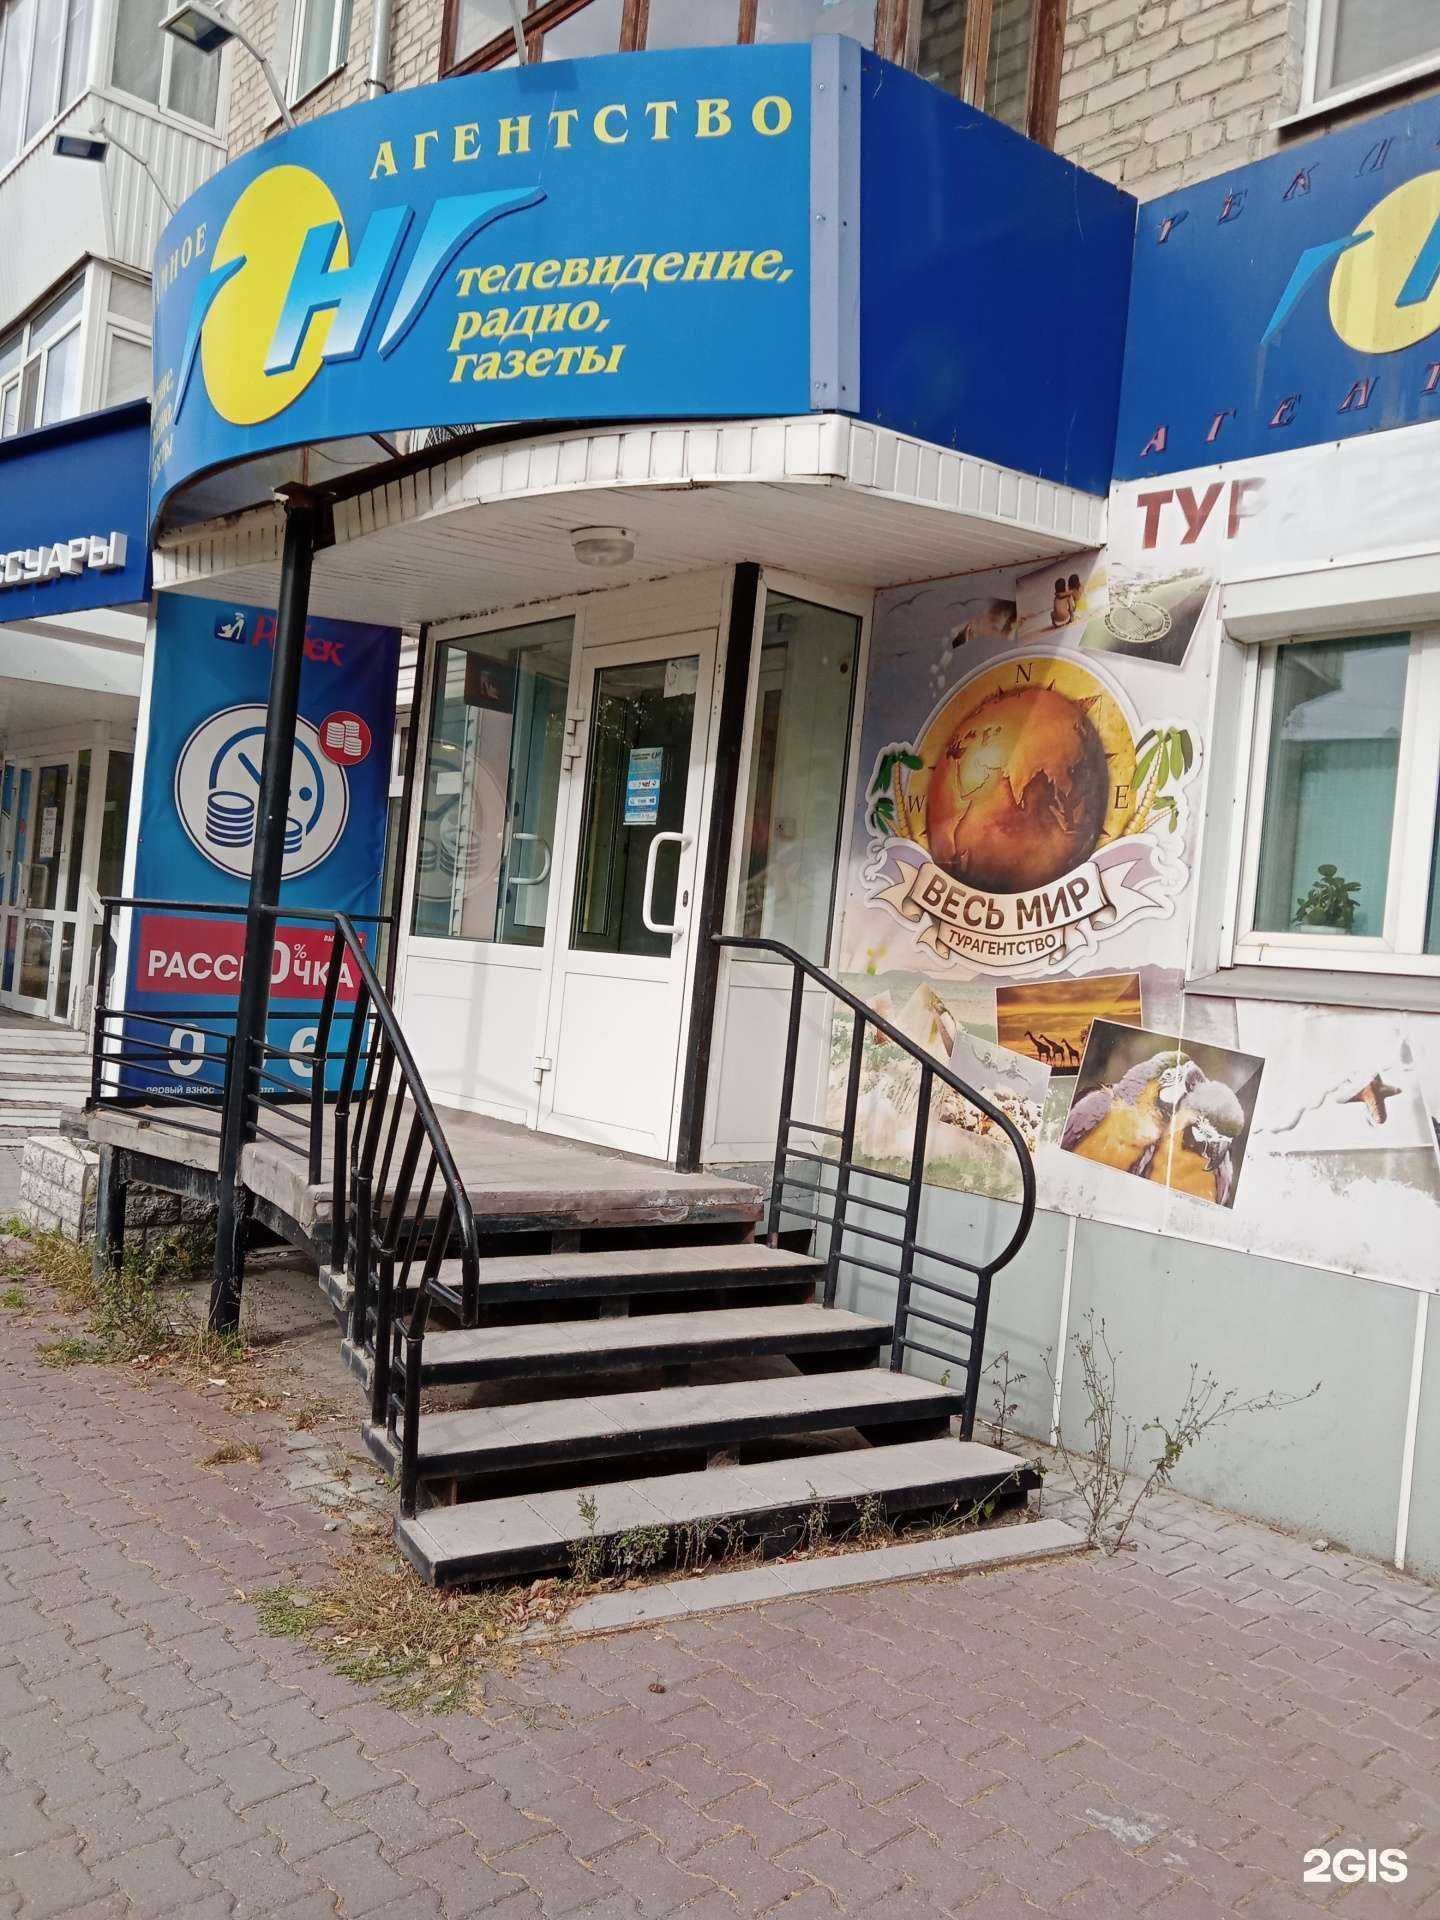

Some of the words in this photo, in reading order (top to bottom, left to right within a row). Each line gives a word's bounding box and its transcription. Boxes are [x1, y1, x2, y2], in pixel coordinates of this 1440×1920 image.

[369, 95, 793, 181] АГЕНТСТВО
[455, 248, 797, 298] телевидение,
[447, 299, 611, 352] радио,
[449, 344, 627, 384] газеты
[1015, 662, 1033, 684] N
[907, 794, 927, 814] W
[1114, 784, 1131, 810] E
[921, 873, 1005, 930] ВЕСЬ
[1016, 876, 1090, 930] МИР
[948, 929, 1057, 956] ТУРАГЕНТСТВО
